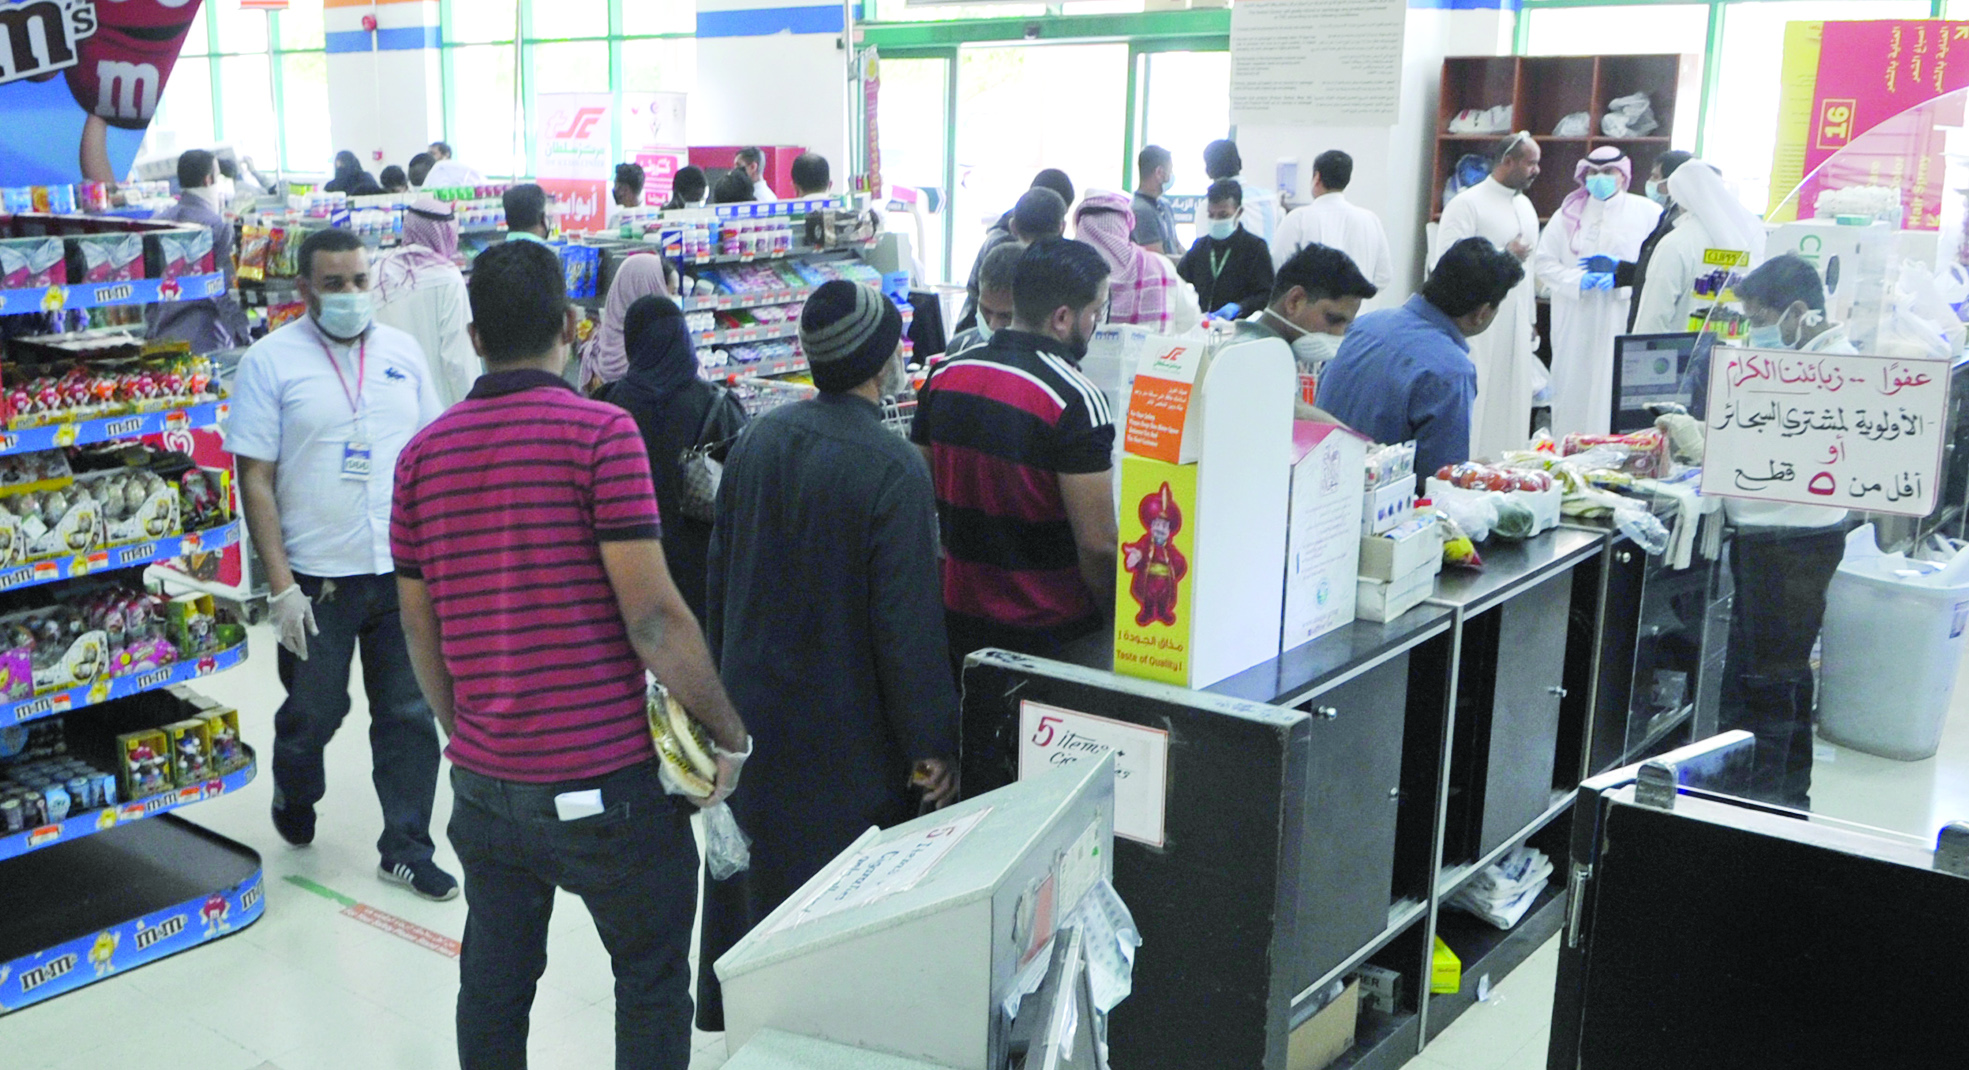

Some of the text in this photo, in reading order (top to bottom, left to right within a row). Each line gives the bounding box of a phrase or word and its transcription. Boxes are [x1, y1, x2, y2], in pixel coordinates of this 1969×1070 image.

[1824, 106, 1849, 139] 16
[1908, 155, 1931, 226] Hair Spray
[1726, 355, 1778, 398] الكرام
[1778, 358, 1843, 391] زبائننا
[1711, 400, 1782, 433] السجائر
[1783, 407, 1849, 438] لمشتري
[1816, 435, 1845, 464] أو
[1735, 460, 1795, 491] قطع
[1850, 477, 1881, 498] من
[1123, 630, 1156, 646] الجودة
[1158, 638, 1184, 652] مذاق
[1116, 650, 1138, 662] Taste
[1139, 655, 1148, 664] of
[1031, 715, 1064, 747] 5
[926, 825, 957, 839] 5
